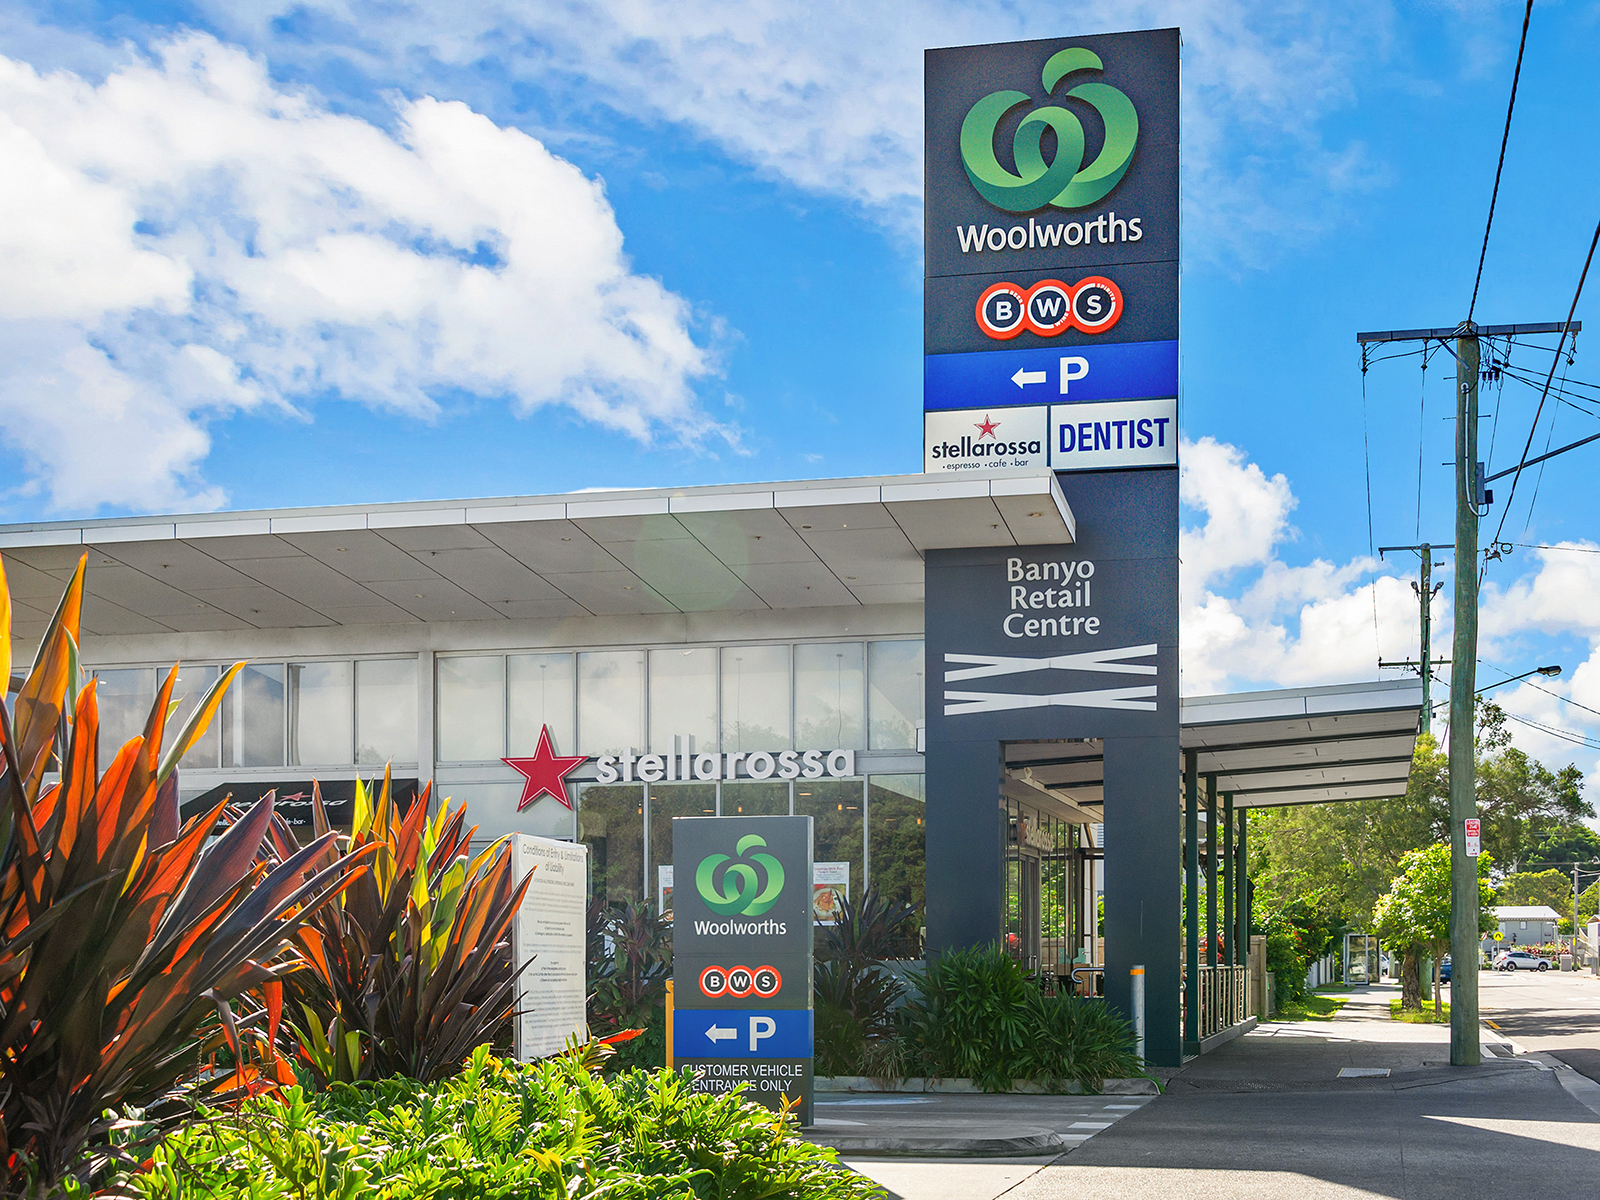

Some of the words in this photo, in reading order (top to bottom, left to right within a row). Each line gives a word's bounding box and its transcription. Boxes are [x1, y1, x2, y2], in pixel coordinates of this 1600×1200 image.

[956, 212, 1143, 253] Woolworths
[1059, 356, 1090, 395] P
[932, 435, 1041, 459] stellarossa
[1059, 418, 1170, 453] DENTIST
[946, 462, 981, 472] espresso
[988, 459, 1007, 468] cafe
[1014, 458, 1029, 467] bar
[1007, 557, 1096, 587] Banyo
[1010, 580, 1092, 610] Retail
[1003, 612, 1101, 638] Centre
[596, 733, 856, 784] stellarossa
[694, 919, 787, 935] Woolworths
[749, 1016, 777, 1051] P
[751, 1064, 803, 1077] VEHICLE
[760, 1080, 792, 1092] ONLY
